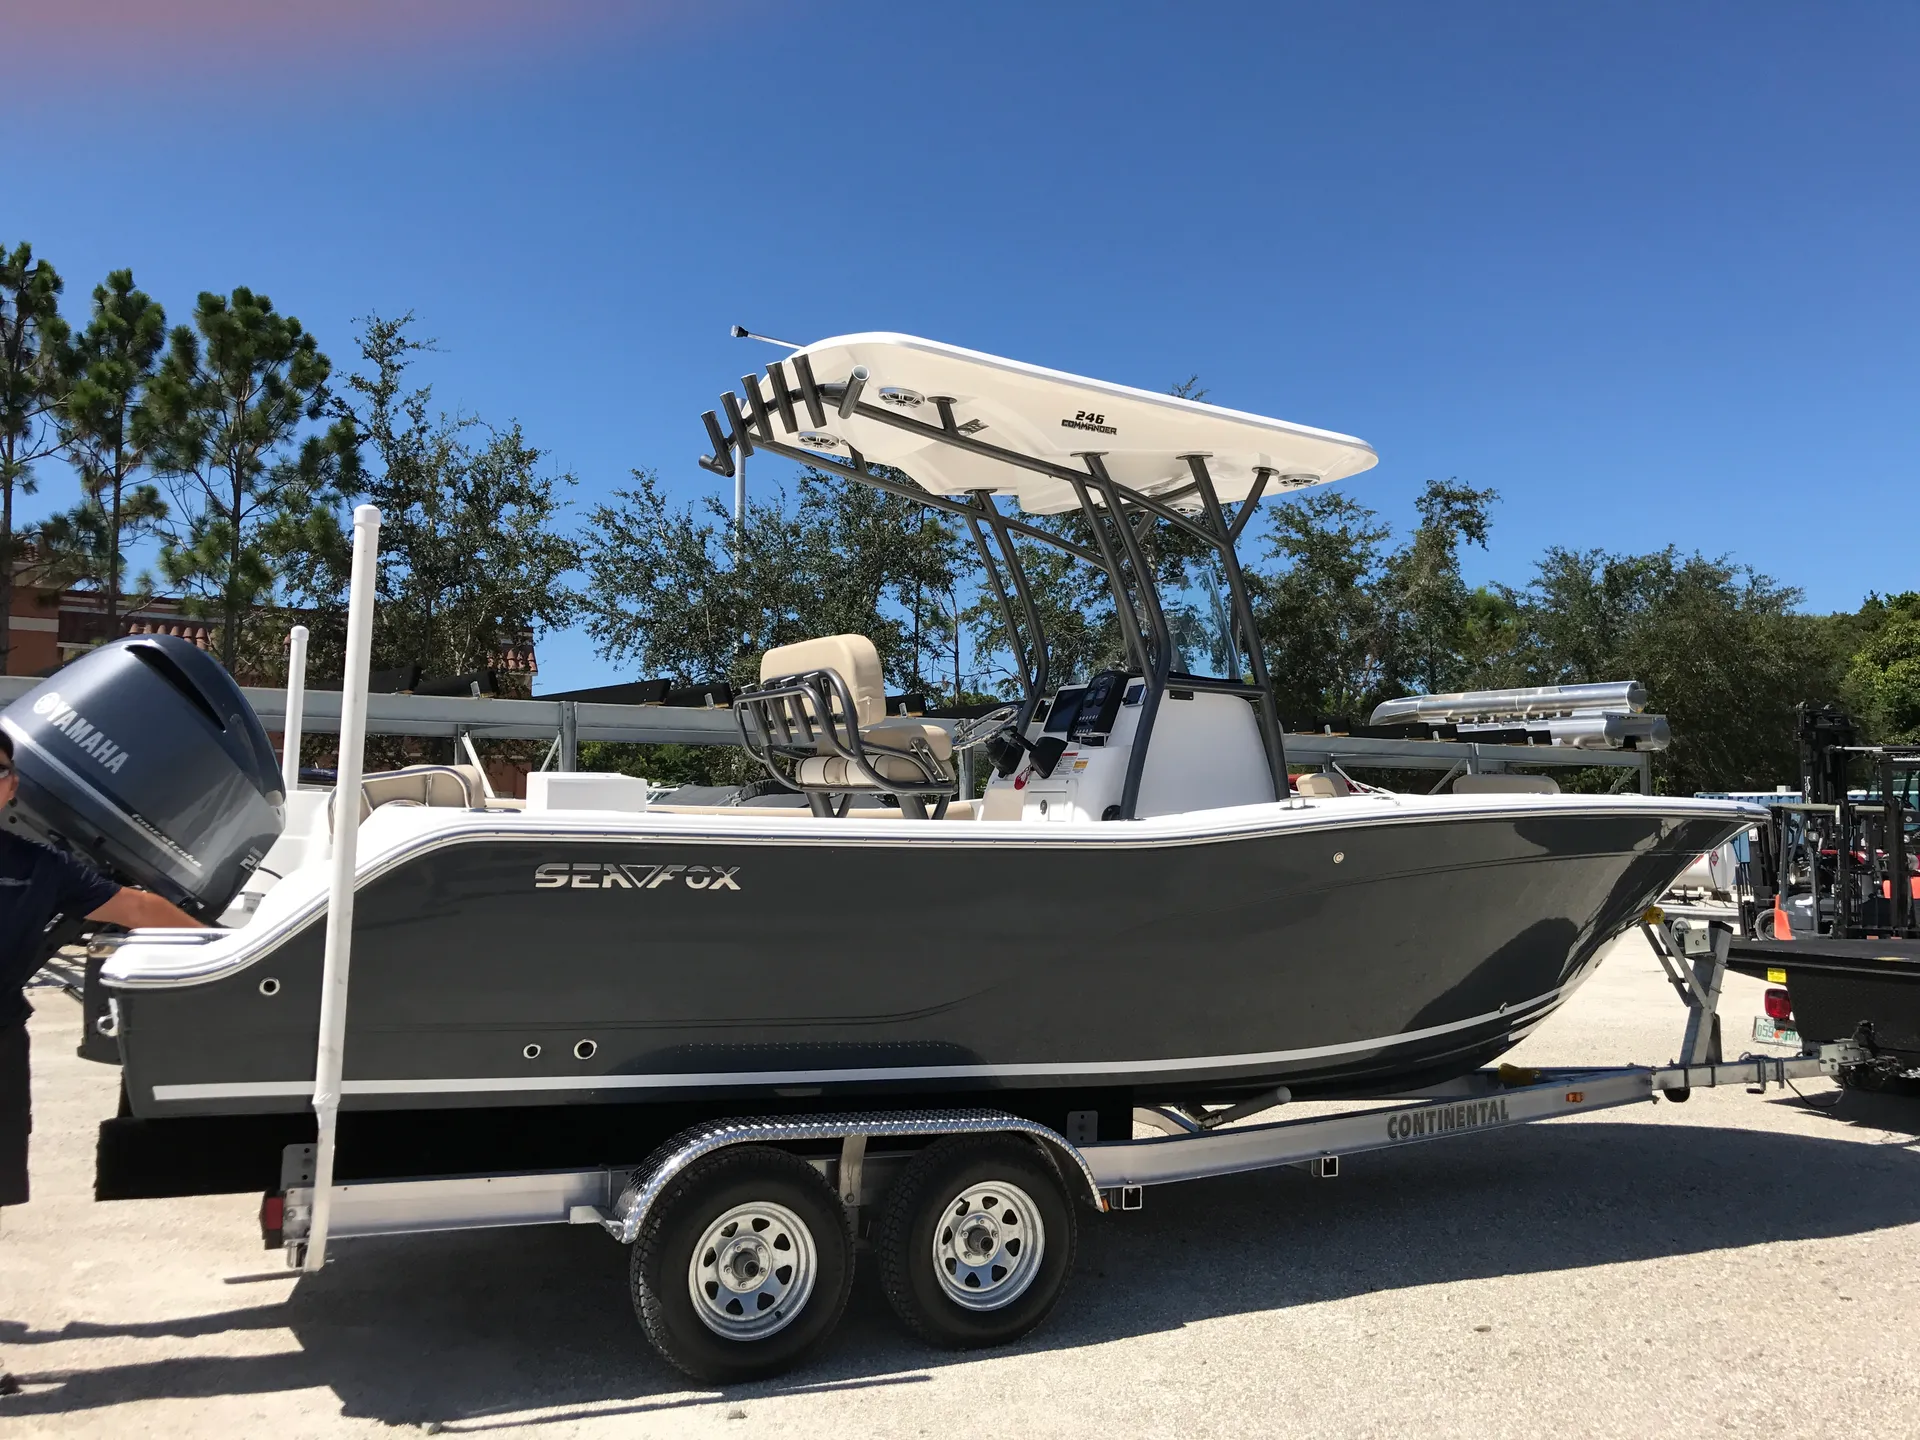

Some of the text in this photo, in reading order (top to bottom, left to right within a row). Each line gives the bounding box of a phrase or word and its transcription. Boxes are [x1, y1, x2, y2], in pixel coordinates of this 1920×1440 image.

[1061, 419, 1118, 436] COMMANDER
[1075, 410, 1105, 425] 246
[46, 700, 129, 774] YAMAHA
[1387, 1099, 1509, 1141] CONTINENTAL
